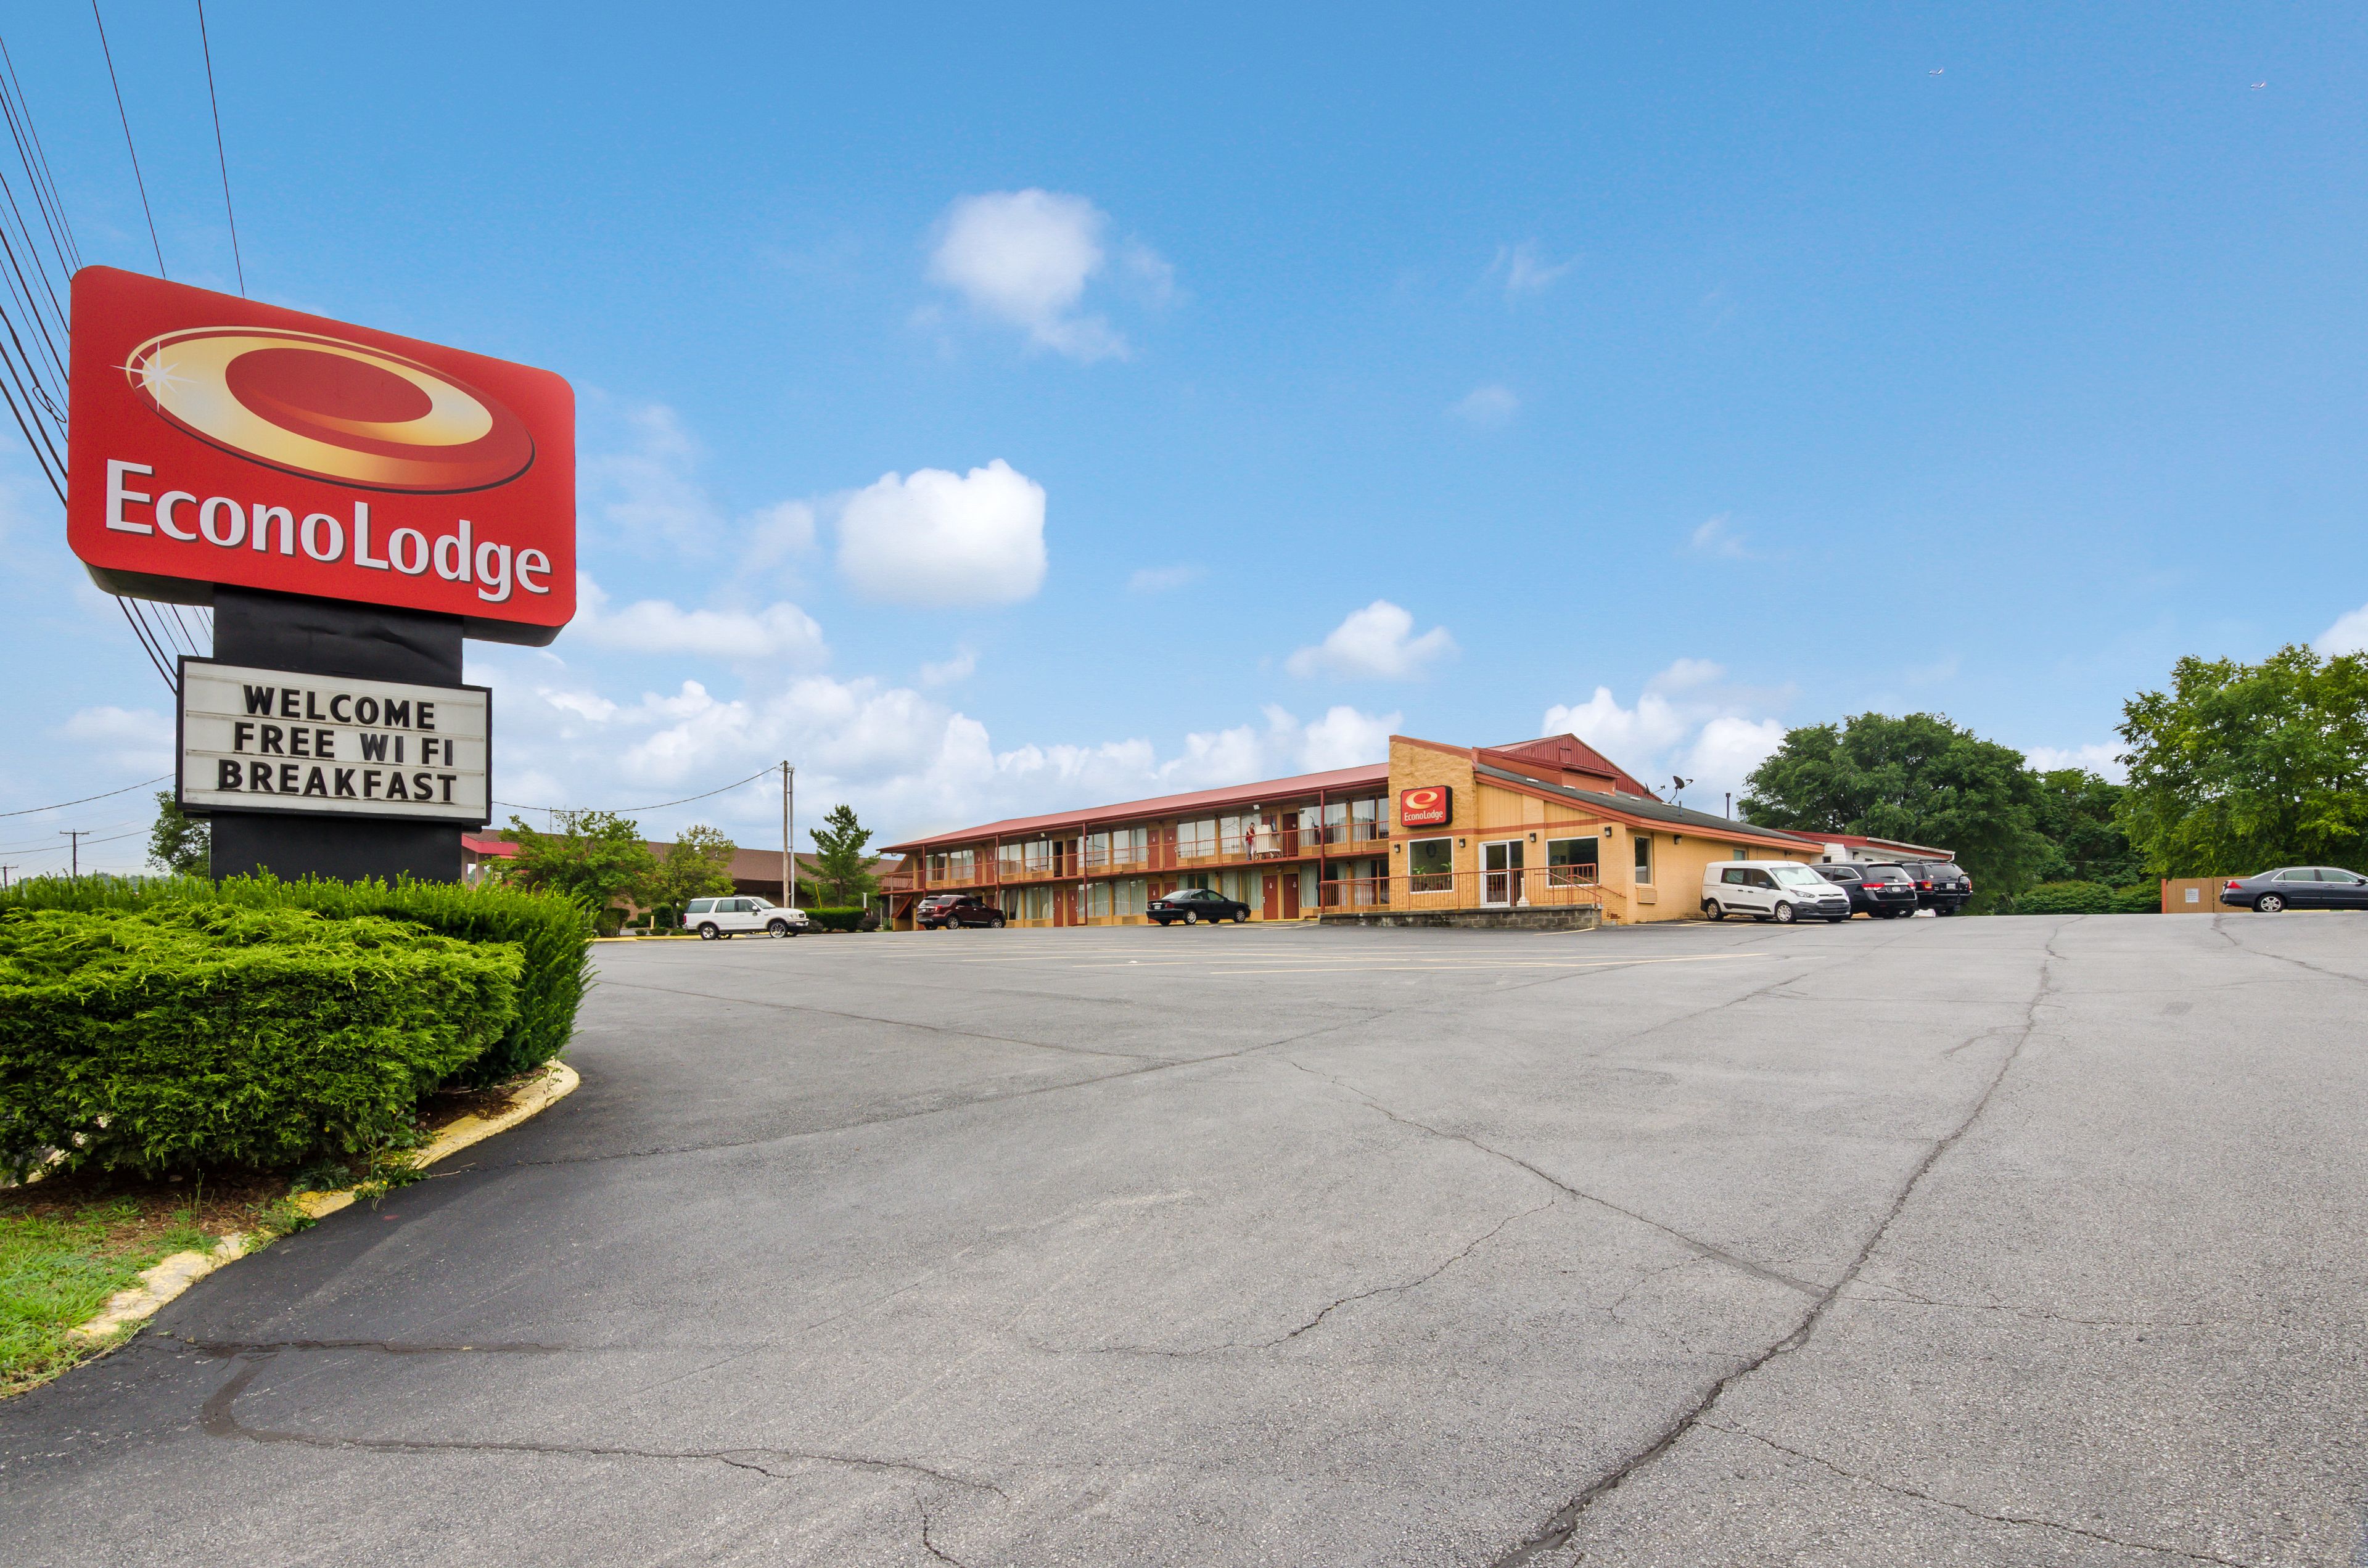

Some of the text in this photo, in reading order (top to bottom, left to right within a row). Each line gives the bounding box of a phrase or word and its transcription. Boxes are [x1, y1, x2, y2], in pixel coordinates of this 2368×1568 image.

[105, 458, 553, 603] EconoLodge
[243, 684, 435, 730] WELCOME
[234, 721, 335, 758] FREE
[218, 758, 457, 802] BREAKFAST
[1404, 809, 1444, 821] EconoLodge
